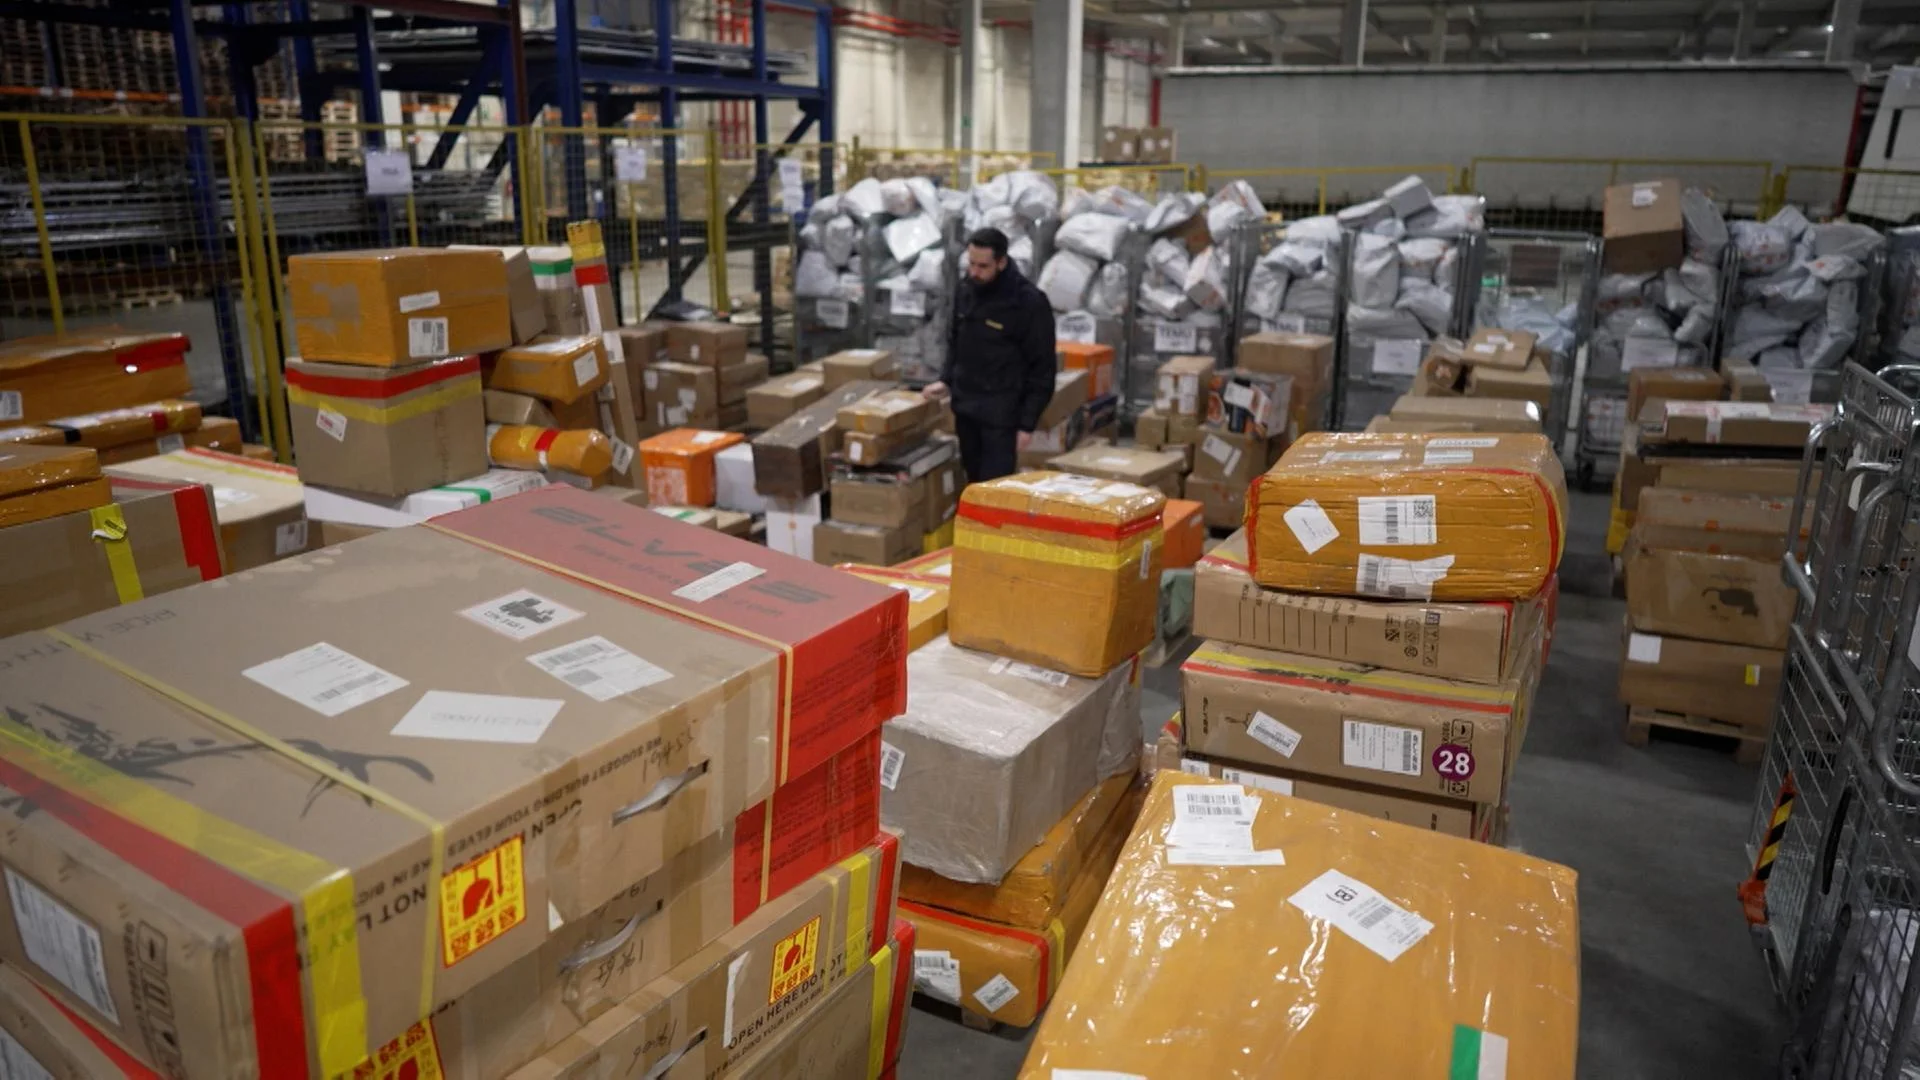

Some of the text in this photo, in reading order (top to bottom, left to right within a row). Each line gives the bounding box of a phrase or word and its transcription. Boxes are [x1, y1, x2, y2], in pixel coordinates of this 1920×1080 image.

[592, 745, 644, 782] SUGGEST
[1438, 749, 1470, 776] 28
[532, 772, 590, 812] BUILDING
[494, 805, 530, 833] YOUR
[447, 825, 492, 858] ELVES
[378, 883, 428, 924] NOT
[728, 1015, 764, 1050] OPEN
[767, 990, 799, 1022] HERE
[802, 974, 818, 994] DO
